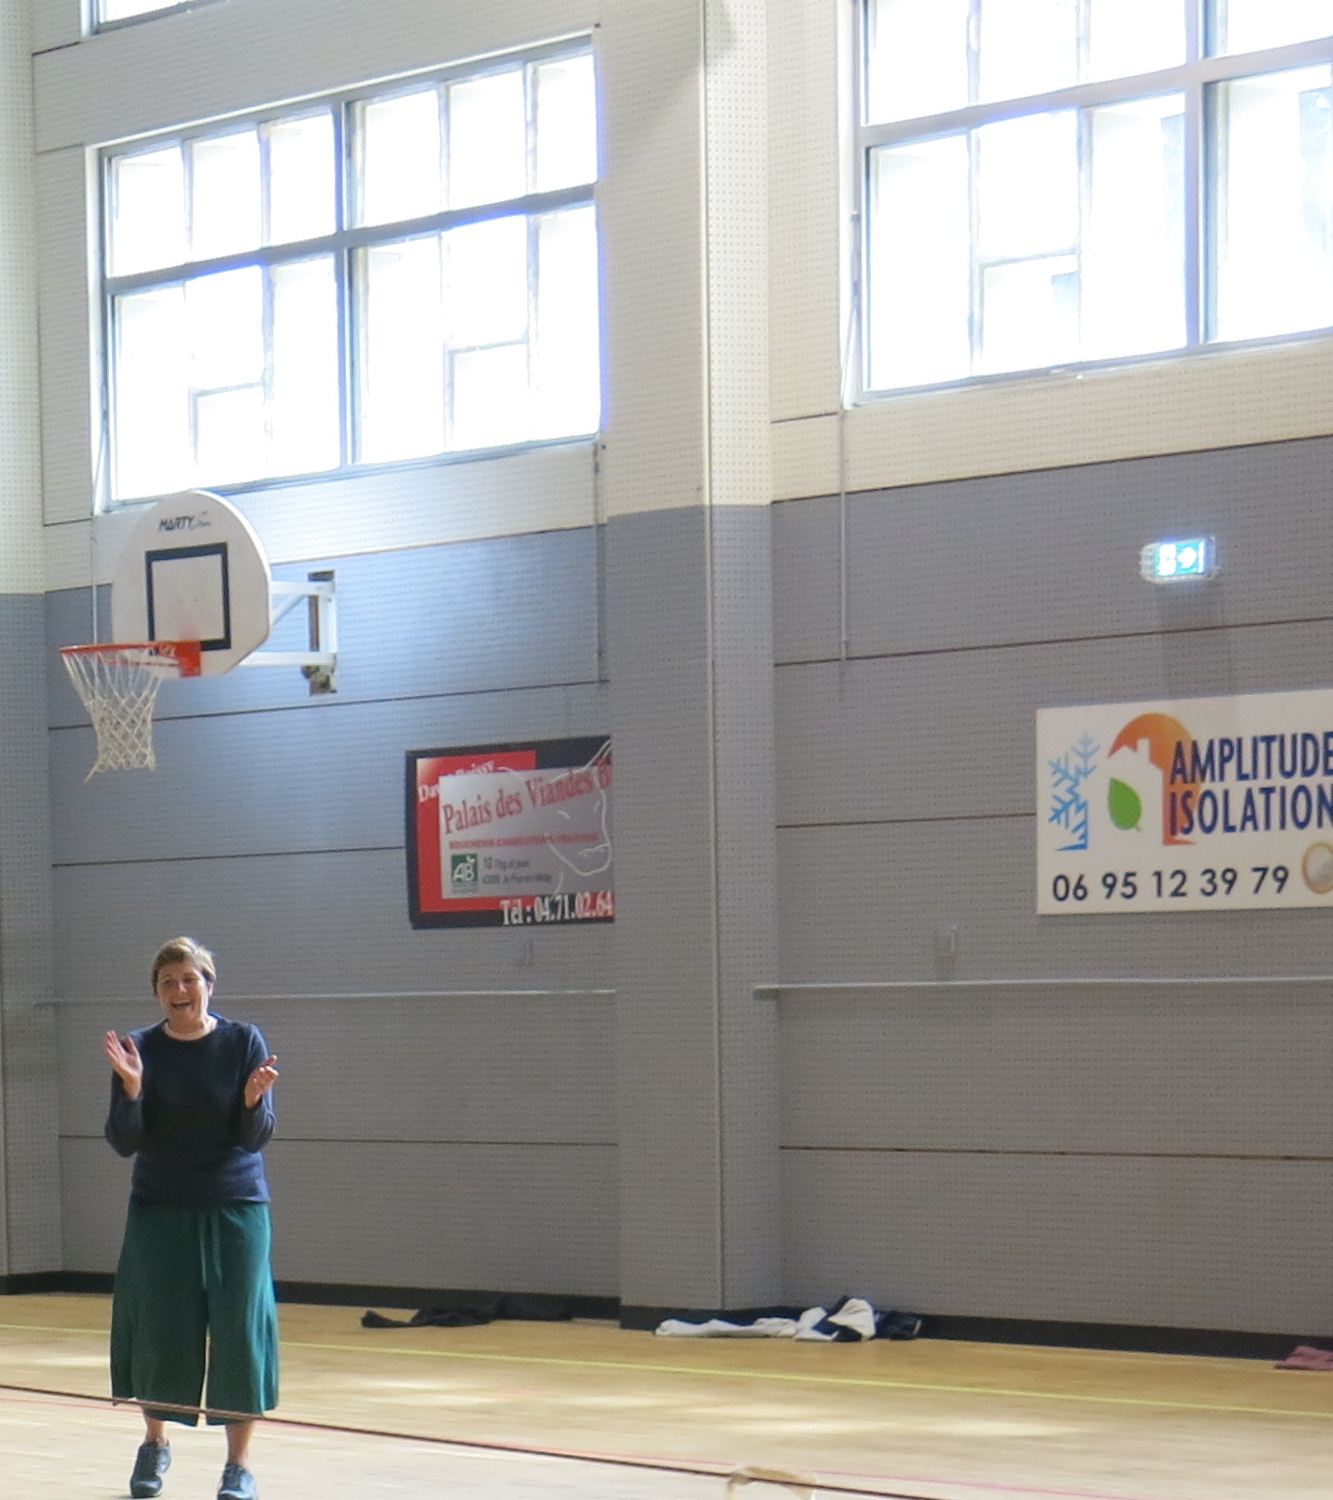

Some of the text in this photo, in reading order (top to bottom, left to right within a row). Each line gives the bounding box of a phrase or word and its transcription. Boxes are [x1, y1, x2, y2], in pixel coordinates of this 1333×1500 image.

[1170, 731, 1333, 785] AMPLITUDE
[442, 795, 493, 835] Palais
[496, 788, 523, 820] des
[526, 768, 594, 808] Viandes
[1170, 784, 1333, 836] ISOLATION
[1052, 865, 1290, 902] 06 95 12 39 79
